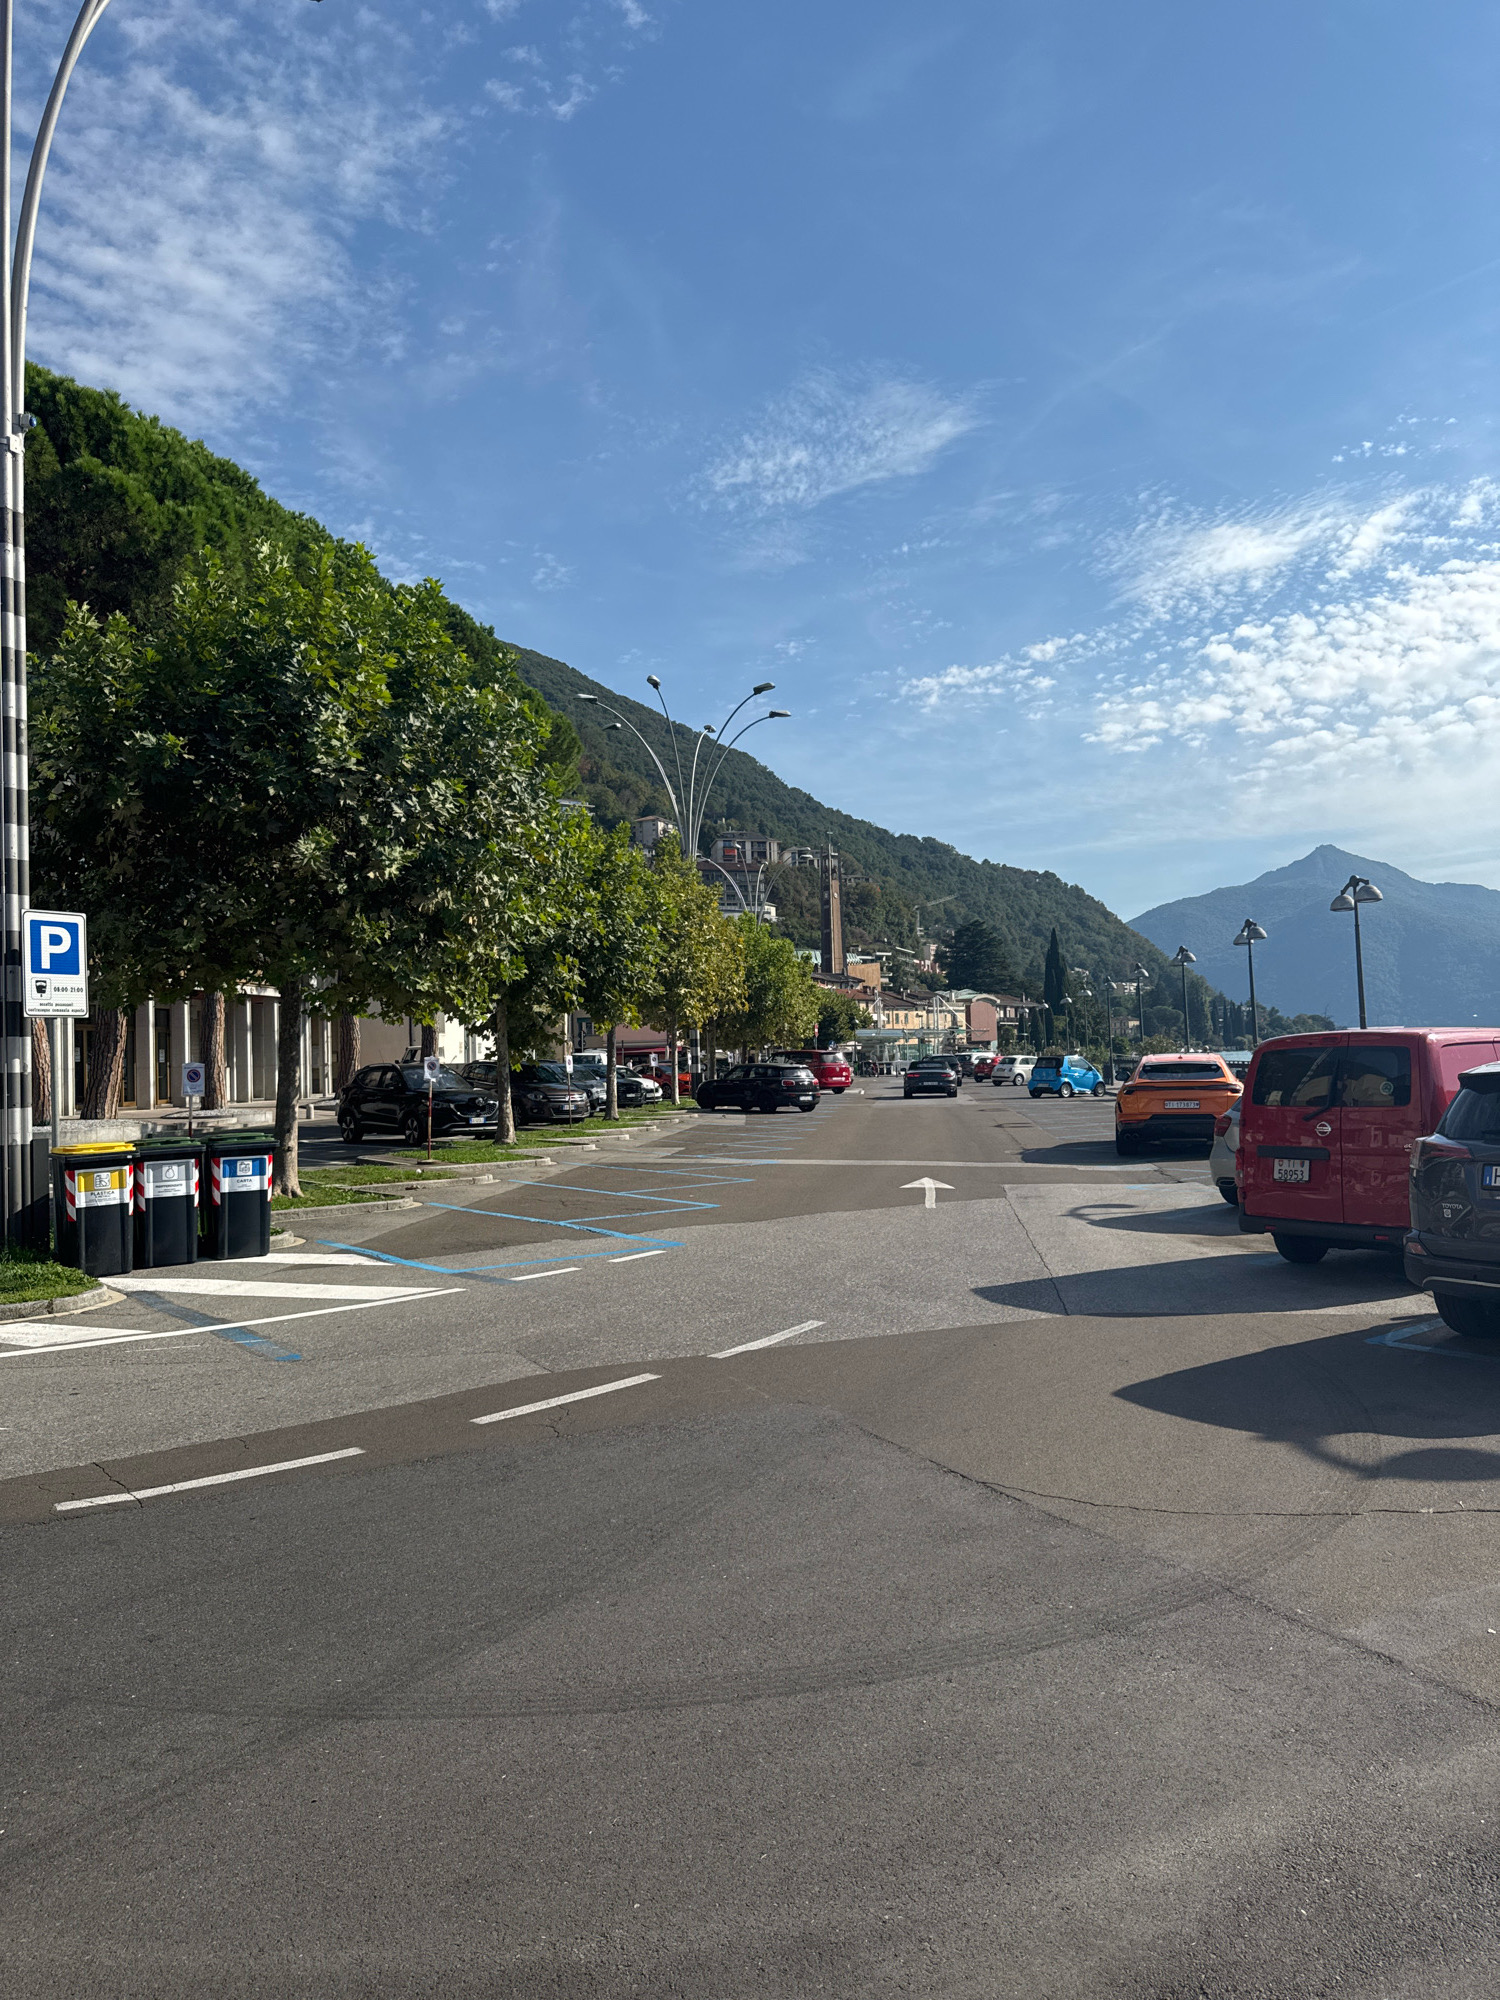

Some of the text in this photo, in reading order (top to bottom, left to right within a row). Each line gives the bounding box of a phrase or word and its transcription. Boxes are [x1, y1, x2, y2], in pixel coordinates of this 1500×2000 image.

[40, 925, 72, 970] P
[1287, 1160, 1296, 1168] TI
[1278, 1169, 1304, 1180] 58953
